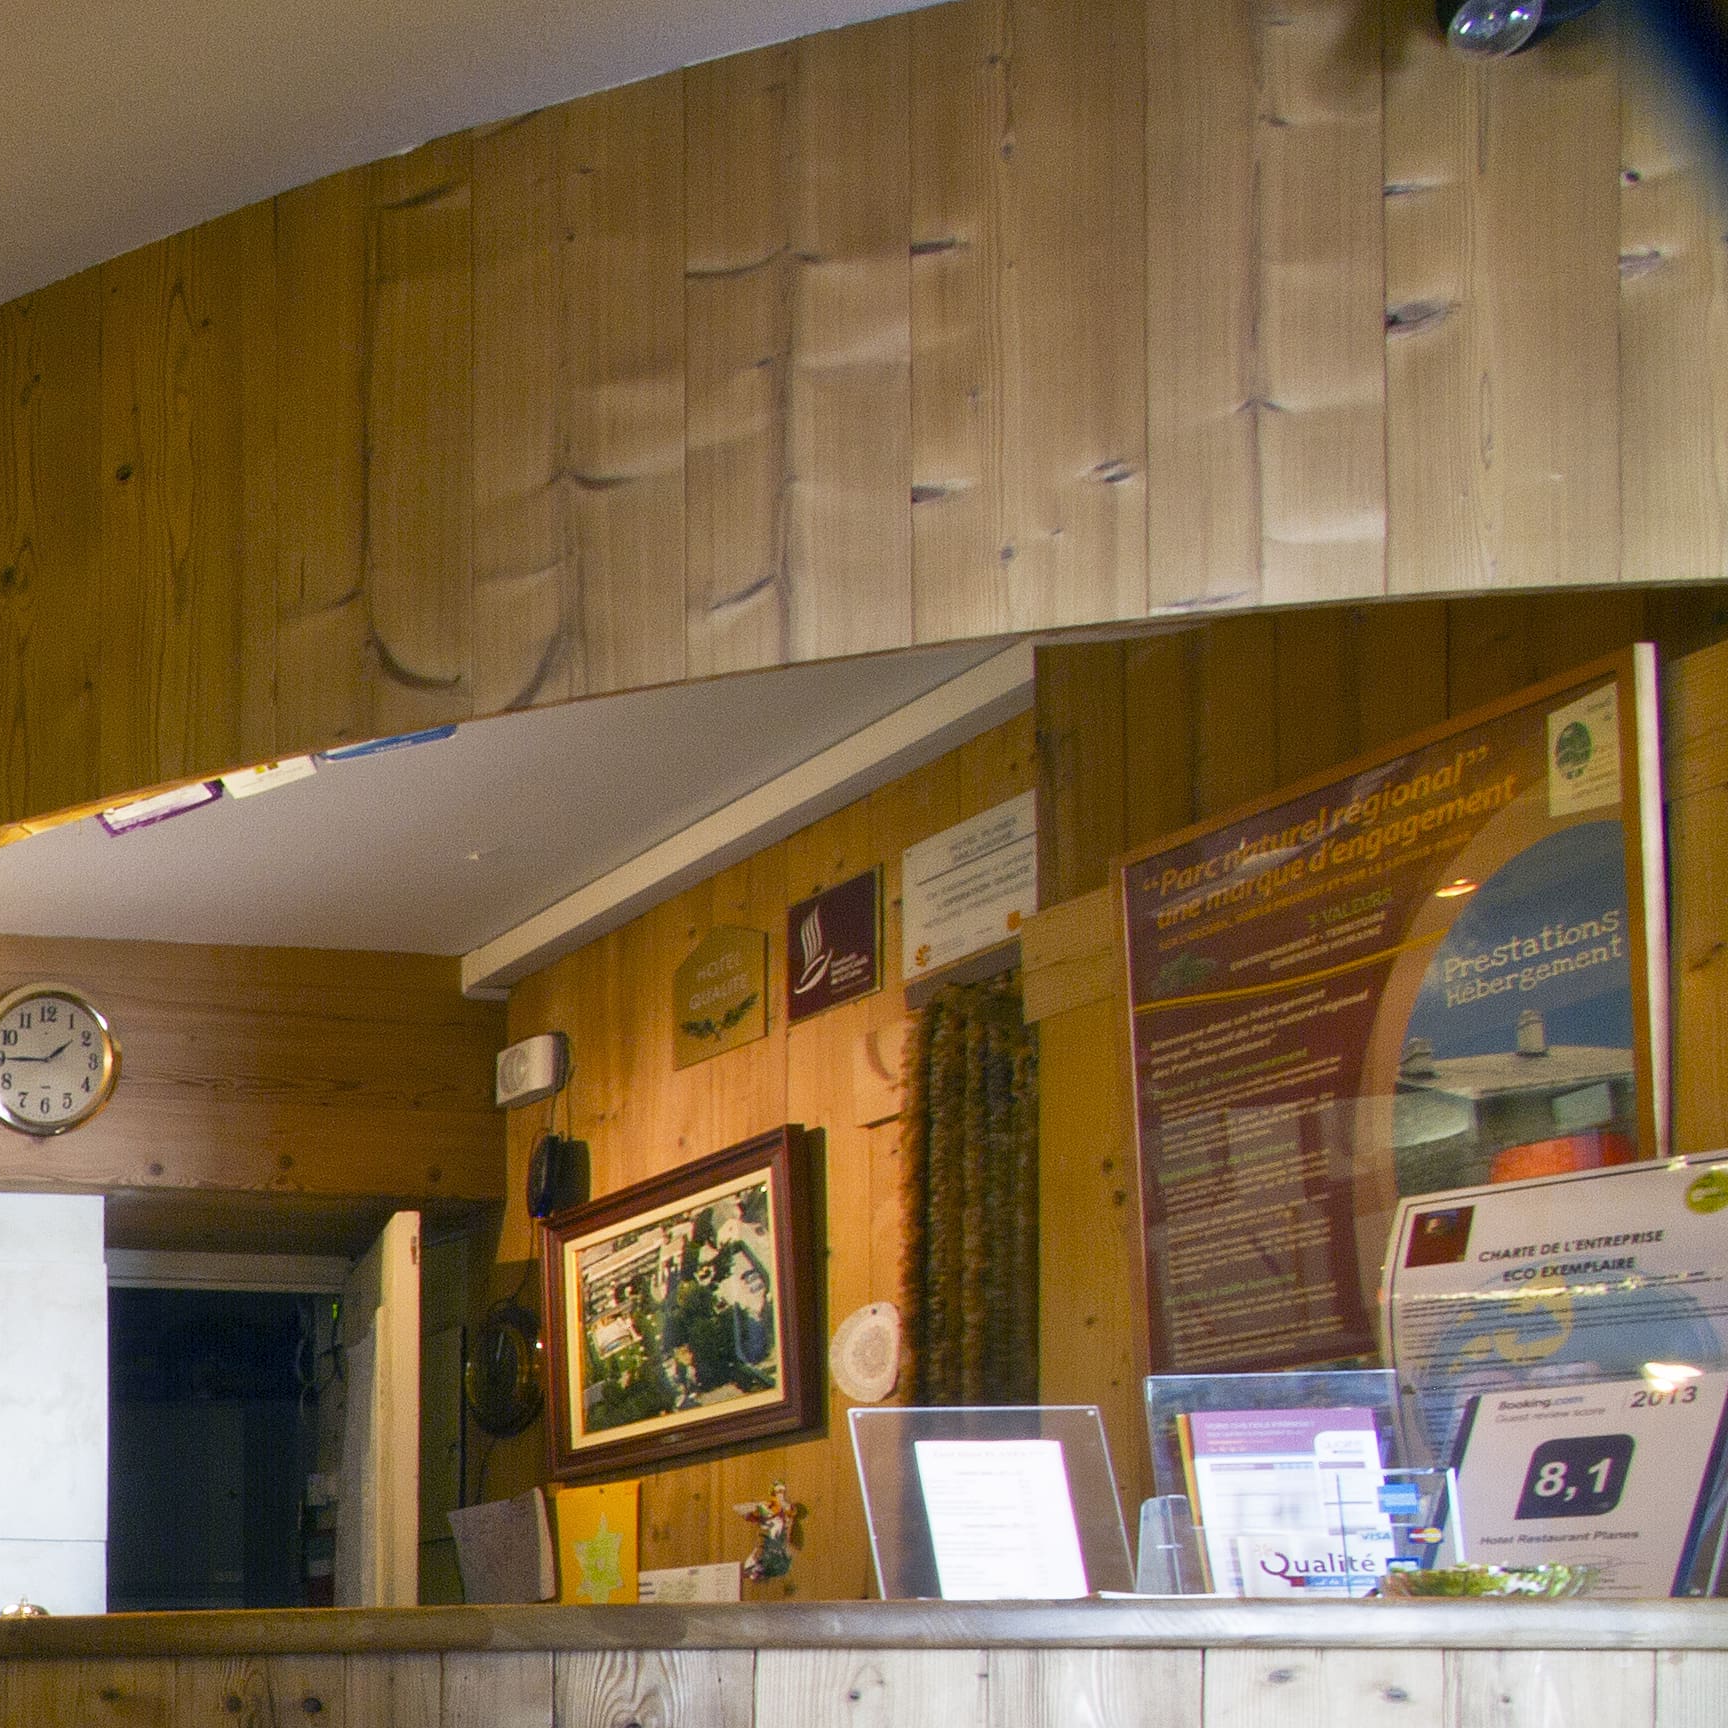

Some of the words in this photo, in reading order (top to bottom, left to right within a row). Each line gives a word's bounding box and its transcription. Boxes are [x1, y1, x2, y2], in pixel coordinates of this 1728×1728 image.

[1156, 900, 1201, 931] une
[1206, 858, 1304, 911] marque
[1443, 908, 1621, 983] Prestations
[19, 1012, 32, 1029] 11
[39, 1005, 58, 1023] 12
[69, 1013, 75, 1030] 1
[1, 1029, 18, 1046] 10
[81, 1030, 92, 1047] 2
[88, 1053, 99, 1071] 3
[1, 1072, 12, 1090] 8
[81, 1075, 91, 1093] 4
[18, 1091, 29, 1109] 7
[40, 1097, 51, 1114] 6
[62, 1092, 73, 1110] 5
[1478, 1244, 1536, 1263] CHARTE
[1540, 1241, 1560, 1256] DE
[1563, 1229, 1666, 1254] L'ENTREPRISE
[1502, 1267, 1537, 1283] ECO
[1540, 1256, 1637, 1280] EXEMPLAIRE
[1497, 1396, 1583, 1411] Booking.com
[1629, 1385, 1699, 1409] 2013
[1533, 1456, 1615, 1503] 8,1
[1360, 1531, 1392, 1541] VISA
[1479, 1534, 1516, 1547] Hotel
[1517, 1531, 1591, 1545] Restaurant
[1592, 1529, 1640, 1542] Planes
[1259, 1551, 1376, 1580] Qualité
